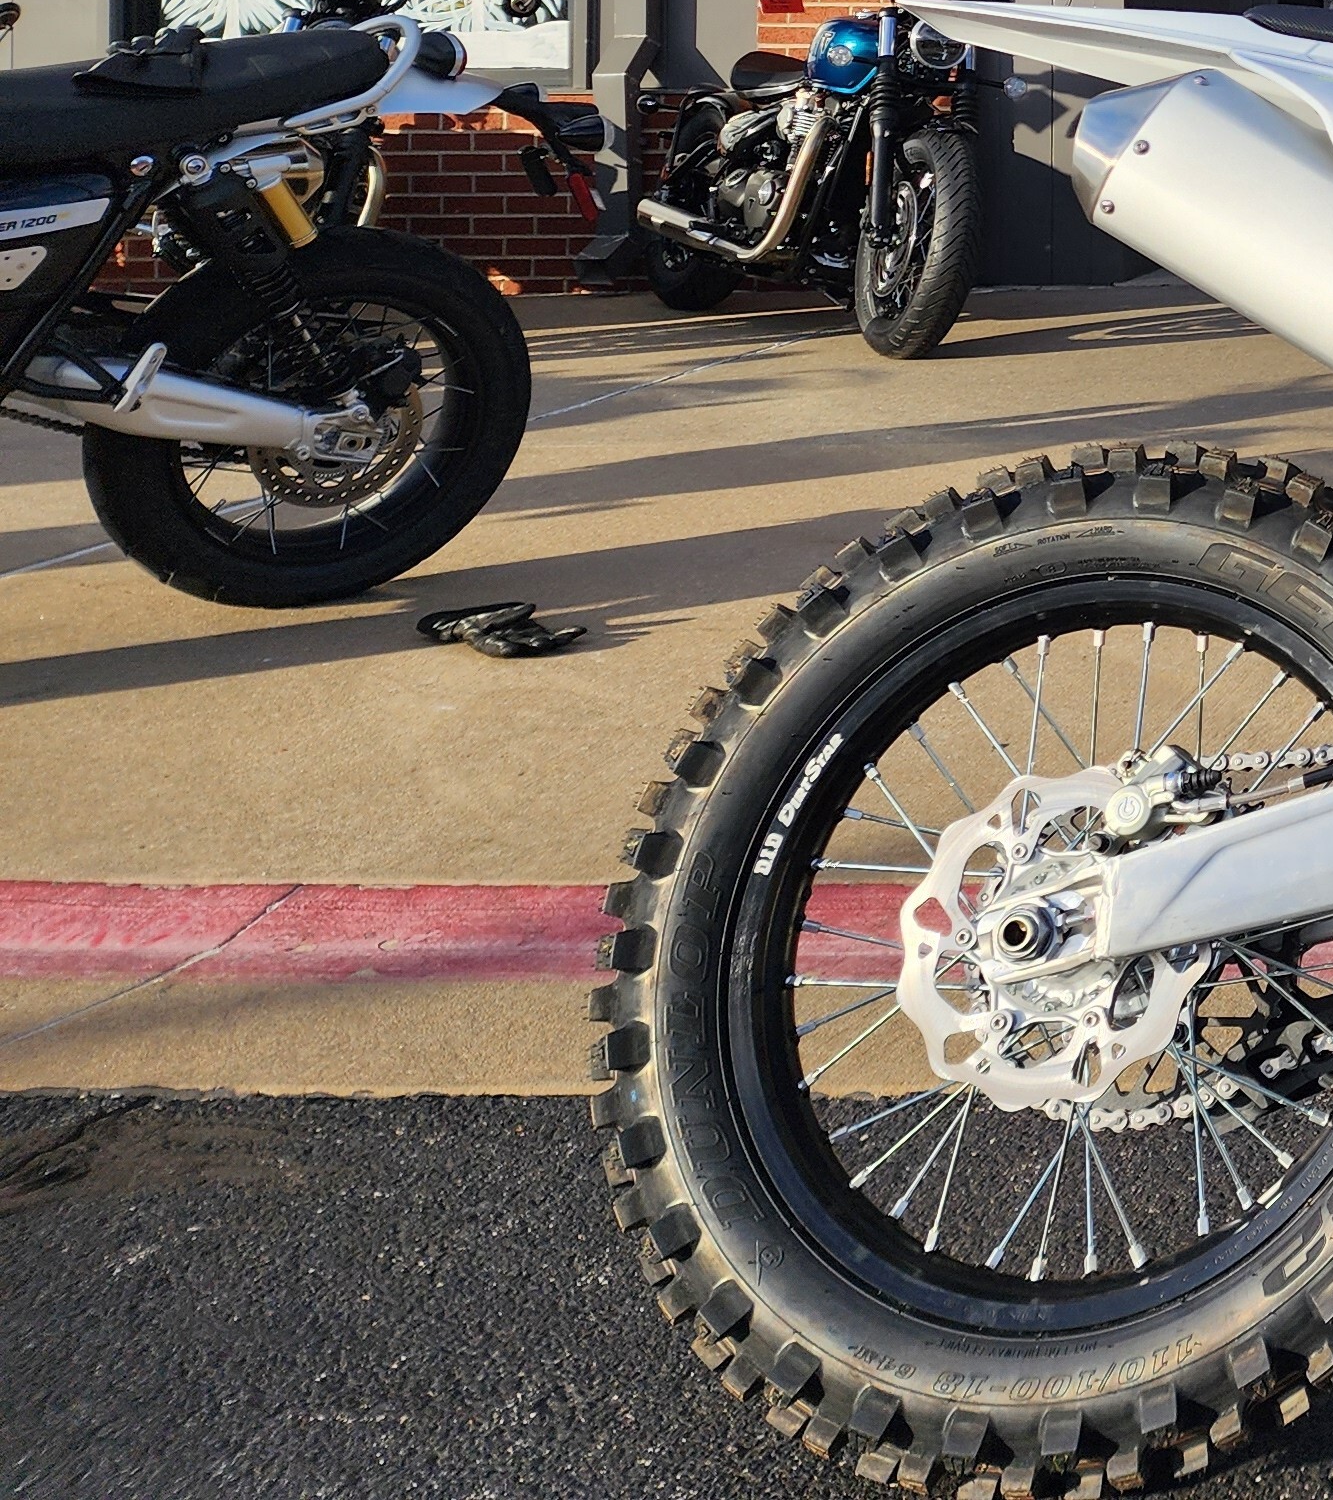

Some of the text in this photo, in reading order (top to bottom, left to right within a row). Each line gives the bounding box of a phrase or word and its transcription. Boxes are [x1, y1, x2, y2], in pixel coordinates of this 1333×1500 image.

[20, 214, 58, 229] 1200
[1036, 533, 1072, 547] ROTATION
[662, 850, 766, 1232] DUNLOP
[932, 1333, 1194, 1400] 110/100-18
